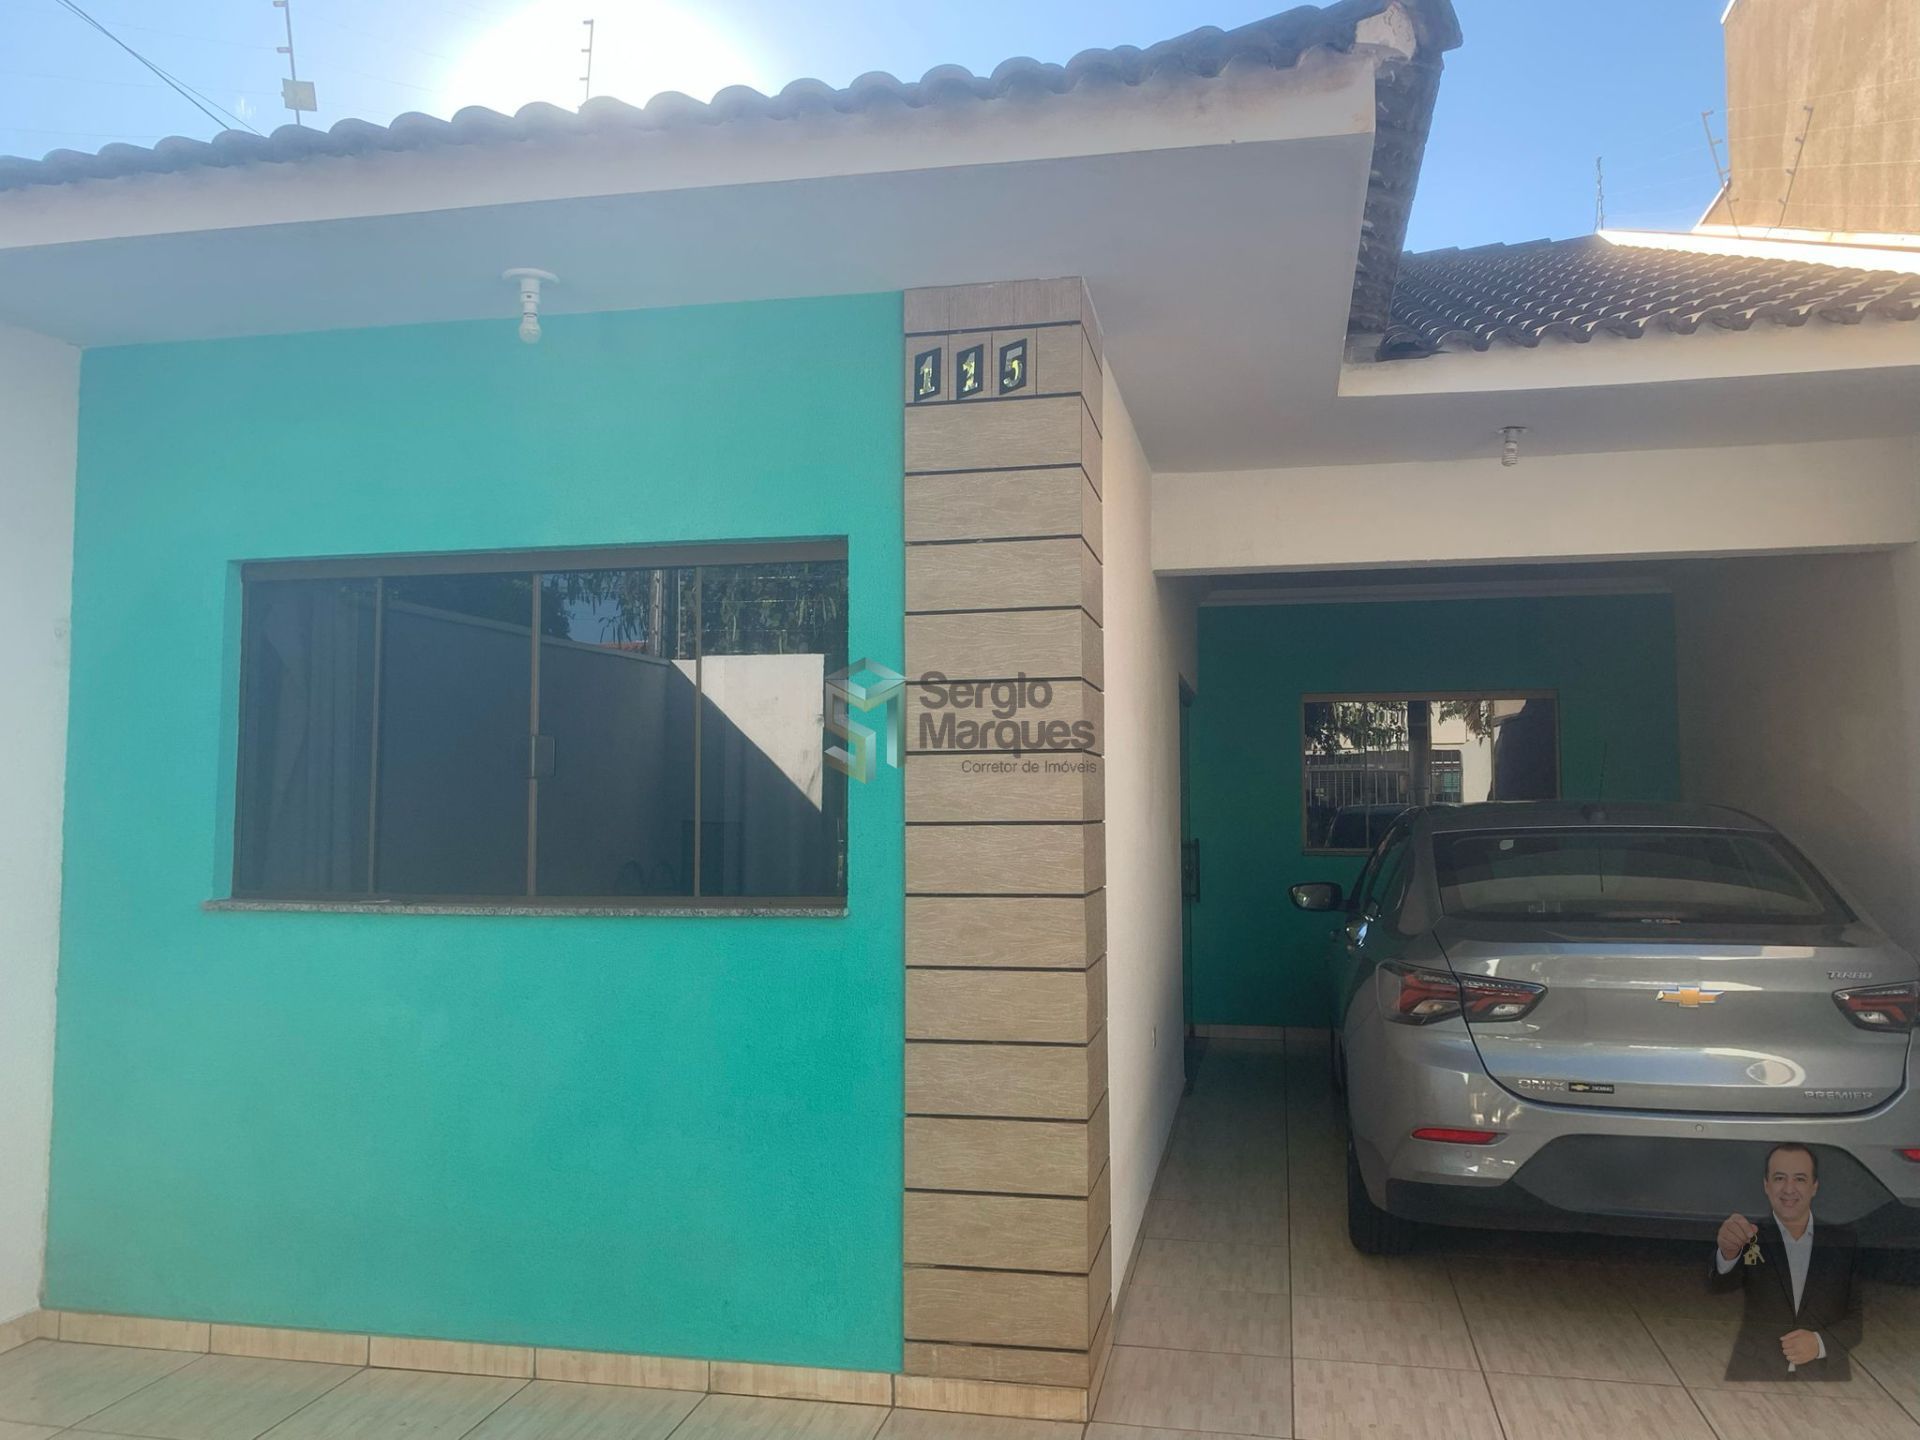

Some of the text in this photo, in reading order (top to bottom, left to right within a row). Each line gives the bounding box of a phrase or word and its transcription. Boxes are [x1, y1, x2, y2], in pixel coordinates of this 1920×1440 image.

[919, 346, 1023, 394] 115
[1518, 1079, 1566, 1092] ONIX
[1803, 1090, 1873, 1100] PREMIER
